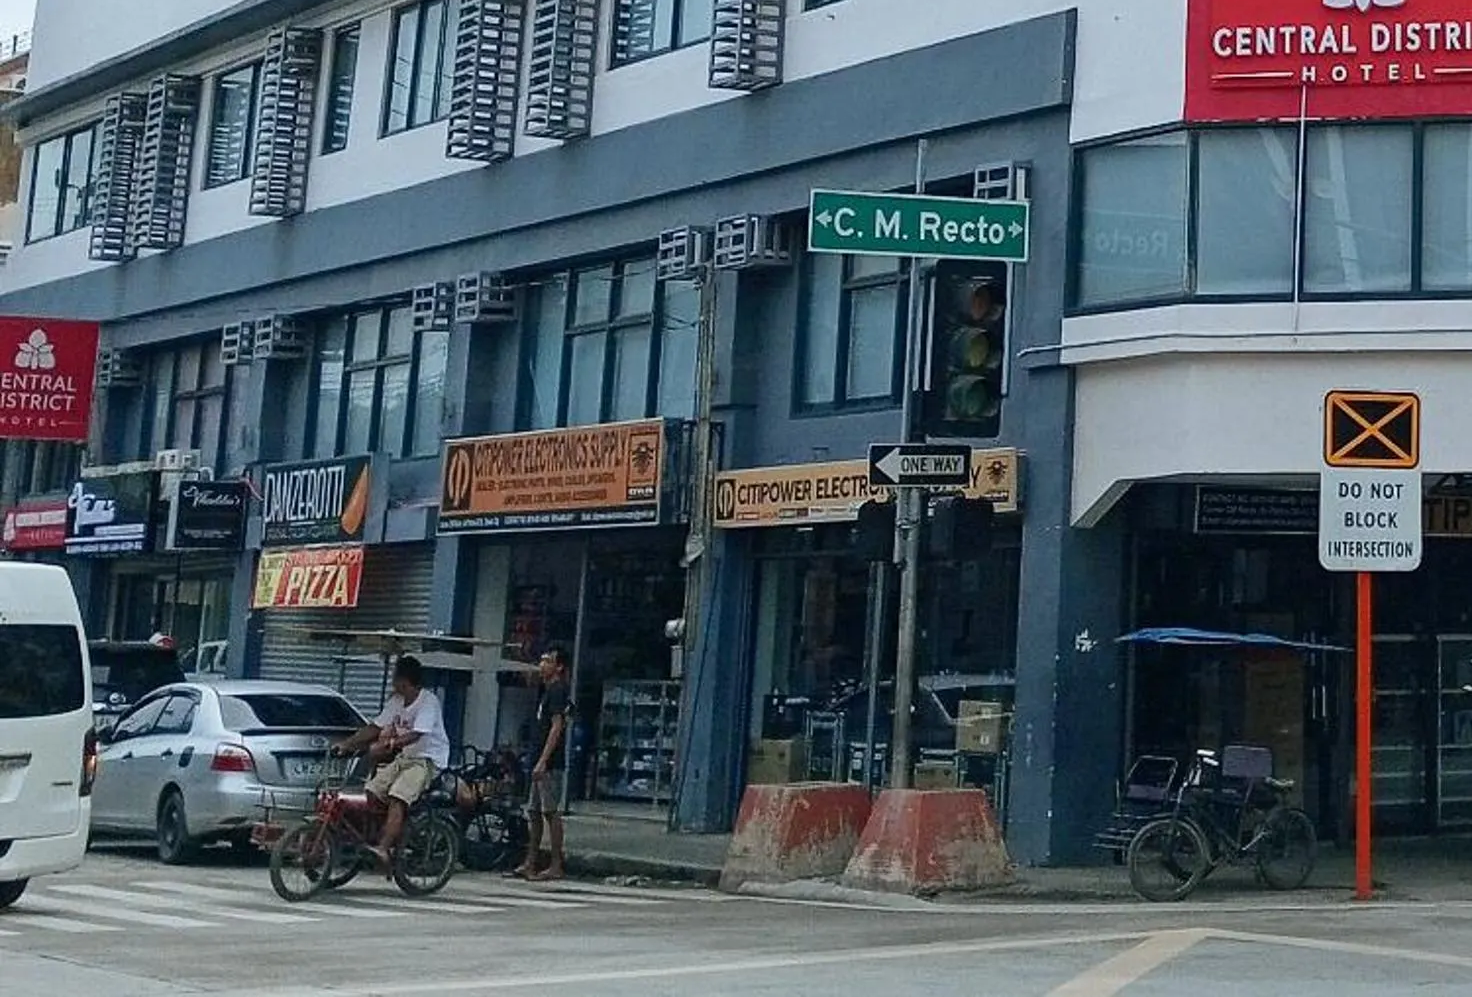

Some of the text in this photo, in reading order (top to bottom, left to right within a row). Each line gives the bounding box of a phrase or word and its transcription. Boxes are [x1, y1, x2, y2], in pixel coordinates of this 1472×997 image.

[1212, 25, 1357, 56] CENTRAL
[1302, 63, 1426, 83] HOTEL
[833, 208, 1005, 244] C. M. Recto
[0, 372, 77, 392] ENTRAL
[0, 392, 75, 411] ISTRICT
[901, 456, 961, 472] ONE WAY
[738, 475, 893, 505] CITIPOWER ELECTR
[1339, 482, 1404, 500] DO NOT
[1344, 512, 1399, 529] BLOCK
[1328, 541, 1413, 559] INTERSECTION
[284, 564, 348, 606] PIZZA
